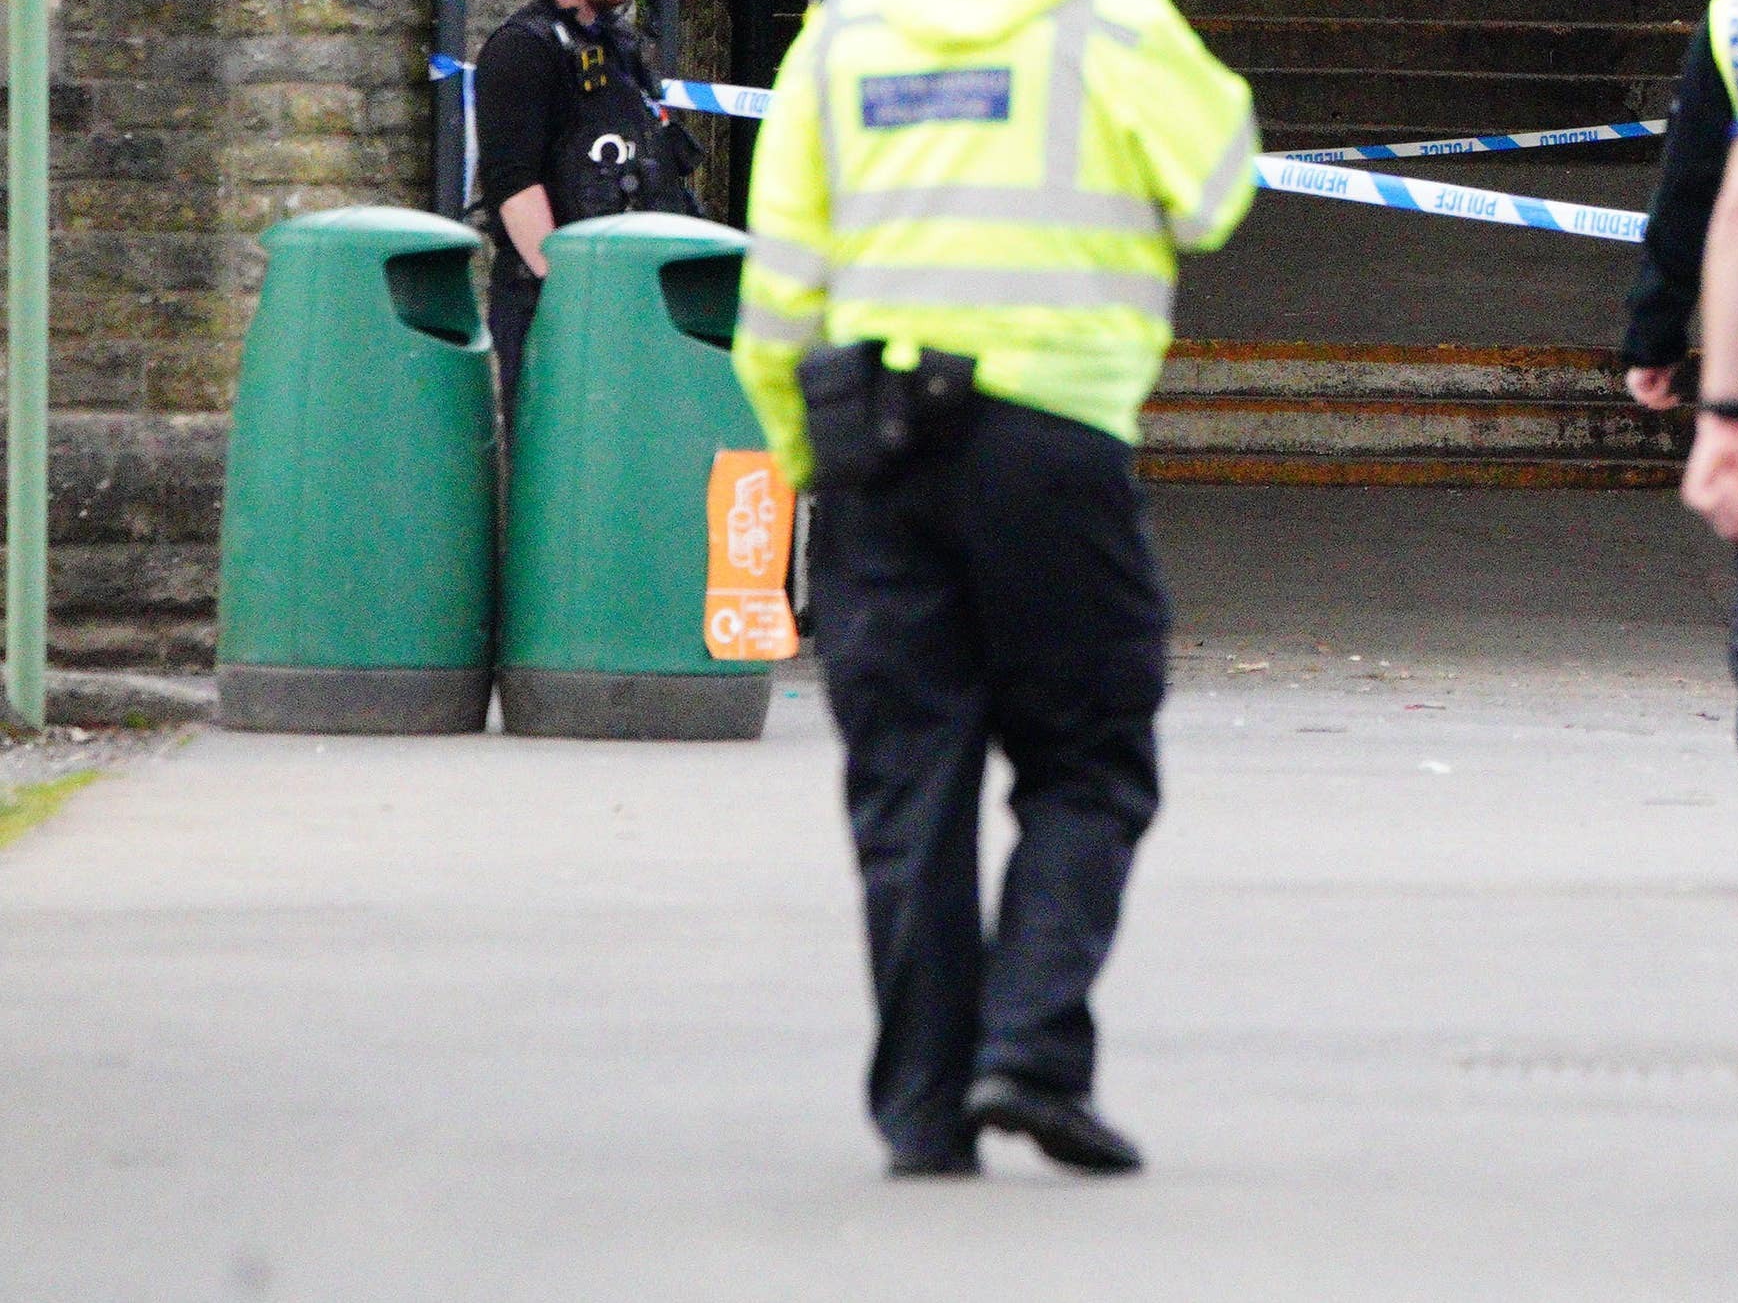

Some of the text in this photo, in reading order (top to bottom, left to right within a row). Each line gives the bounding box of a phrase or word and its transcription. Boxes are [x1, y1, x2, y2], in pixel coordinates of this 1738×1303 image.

[1279, 164, 1644, 238] HEDDLU POLICE HEDDLU
